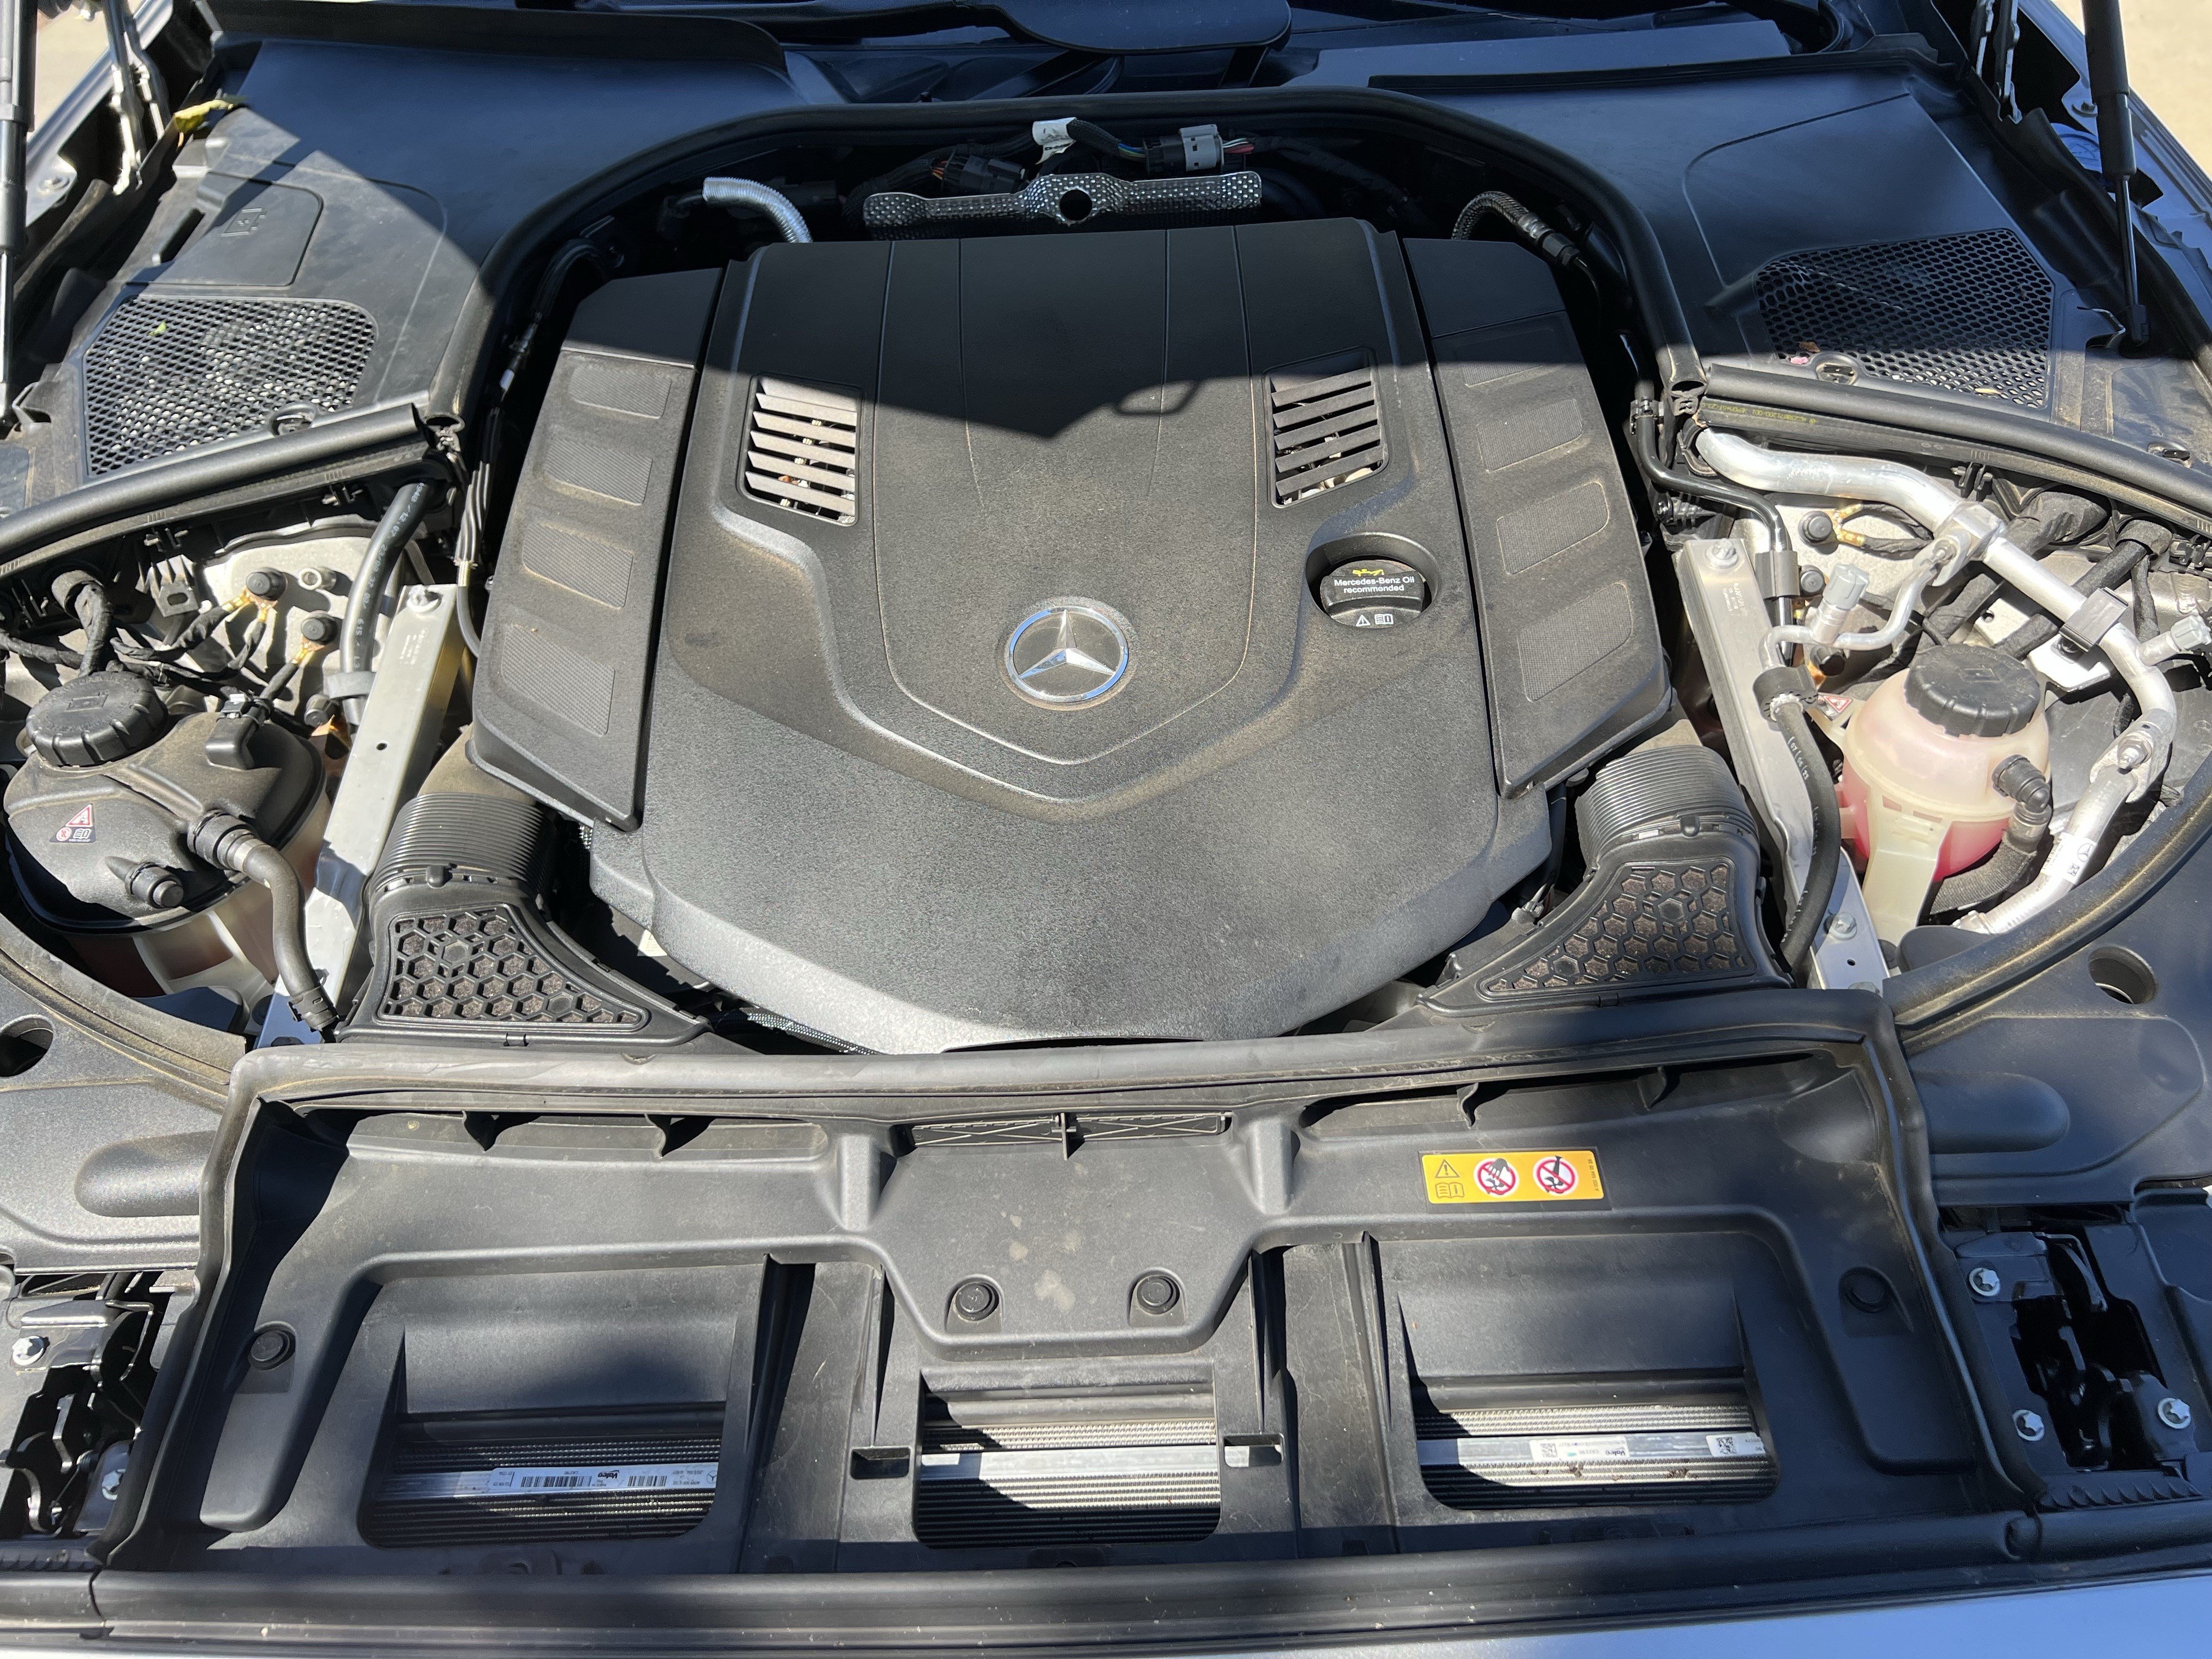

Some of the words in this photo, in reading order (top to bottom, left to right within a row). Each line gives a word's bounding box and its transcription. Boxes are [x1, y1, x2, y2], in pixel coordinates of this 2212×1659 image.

[1334, 577, 1401, 587] Mercedes-Benz
[1402, 575, 1415, 584] Oil
[1344, 584, 1405, 594] recommended
[597, 1470, 619, 1480] Valeo
